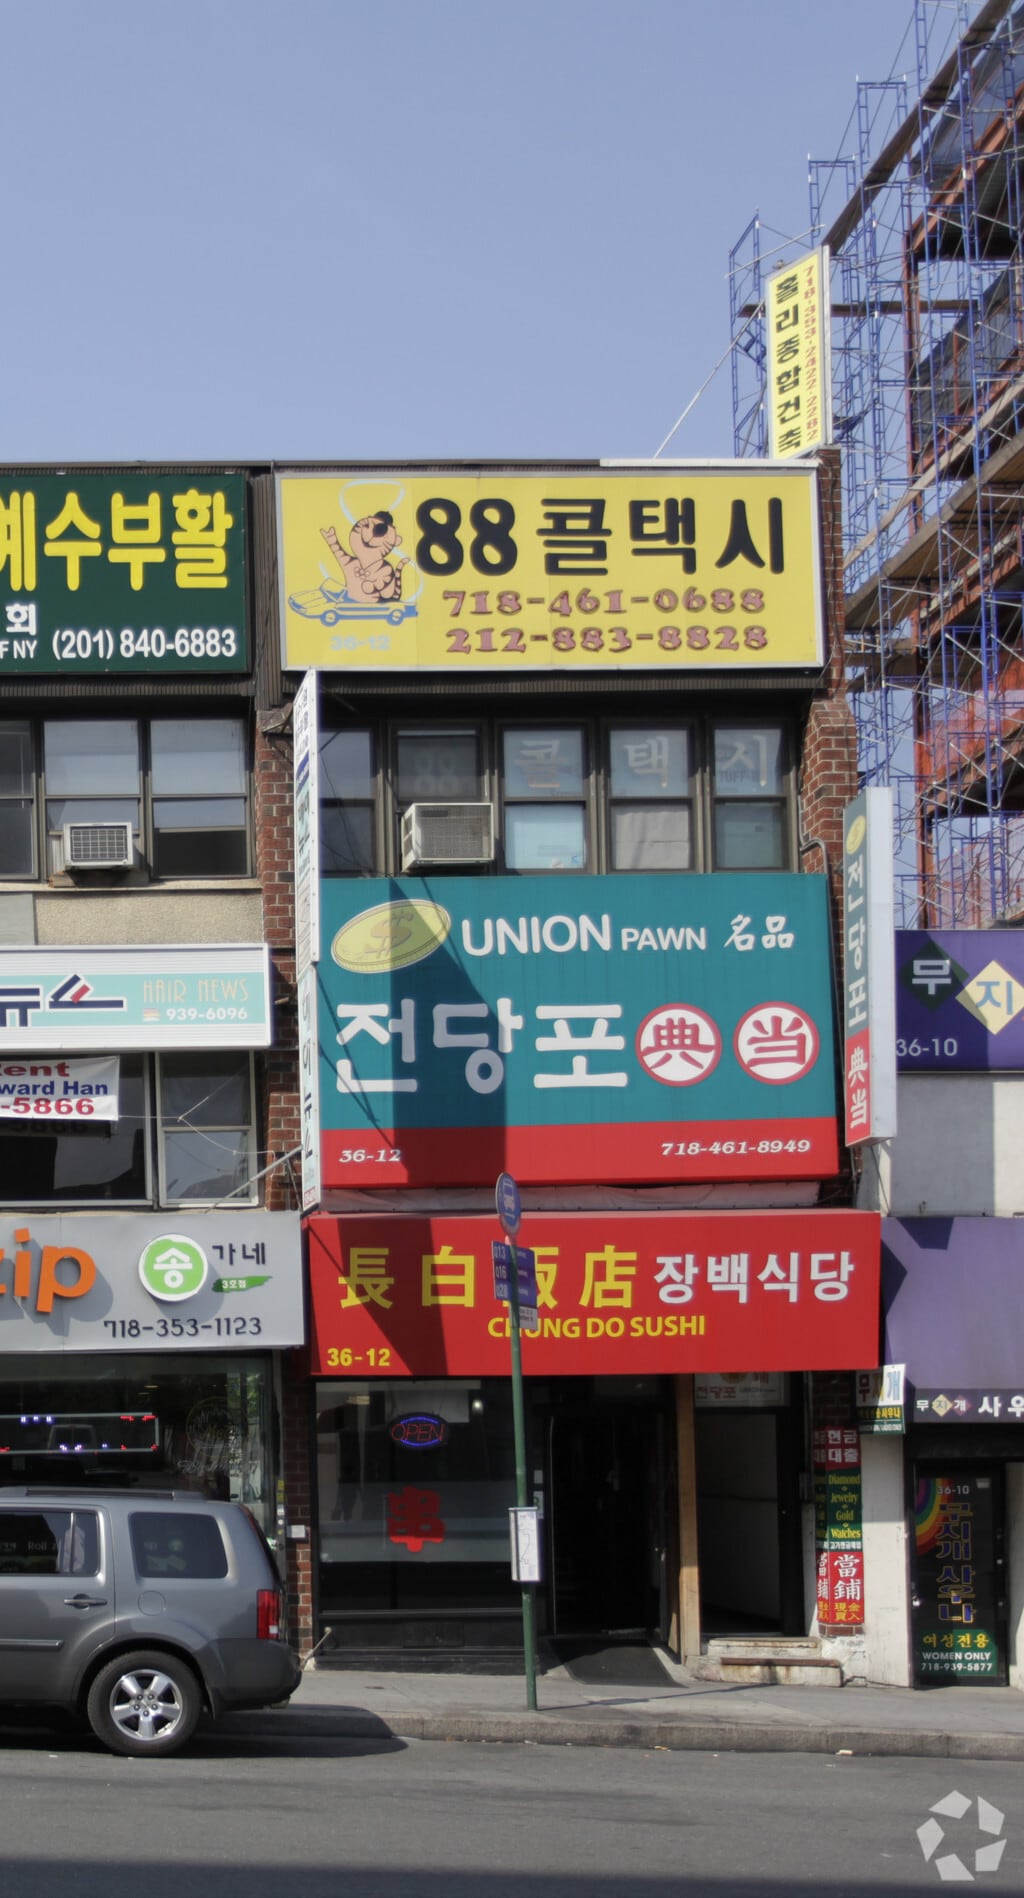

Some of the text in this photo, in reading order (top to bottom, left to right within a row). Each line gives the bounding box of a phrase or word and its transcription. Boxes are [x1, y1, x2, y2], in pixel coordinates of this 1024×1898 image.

[443, 588, 766, 618] 718-461-0688
[12, 639, 38, 660] NY
[52, 628, 237, 660] (201) 840-6883
[330, 634, 392, 652] 36-12
[445, 626, 769, 655] 212-883-8828
[462, 912, 796, 957] UNION PAWN 名品
[847, 853, 868, 1028] 전당포
[143, 977, 249, 1003] HAIR NEWS
[166, 1007, 248, 1021] 939-6096
[334, 997, 630, 1096] 전당포
[896, 1038, 958, 1057] 36-10
[63, 1080, 109, 1096] Han
[338, 1148, 403, 1163] 36-12
[661, 1139, 812, 1156] 718-461-8949
[151, 1241, 266, 1290] 송 가네
[652, 1250, 855, 1304] 장백식당
[103, 1316, 263, 1338] 718-353-1123
[586, 1316, 625, 1338] DO
[629, 1314, 705, 1337] SUSHI
[327, 1347, 392, 1367] 36-12
[391, 1423, 446, 1442] OPEN
[828, 1430, 858, 1445] 현금
[828, 1448, 859, 1464] 대출
[828, 1475, 861, 1486] Diamond
[831, 1492, 859, 1505] Jewelry
[936, 1485, 970, 1496] 36-10
[835, 1510, 855, 1521] Gold
[830, 1528, 862, 1539] Watches
[833, 1554, 861, 1601] 當鋪
[922, 1651, 991, 1661] WOMEN ONLY
[921, 1662, 993, 1673] 718-939-5877
